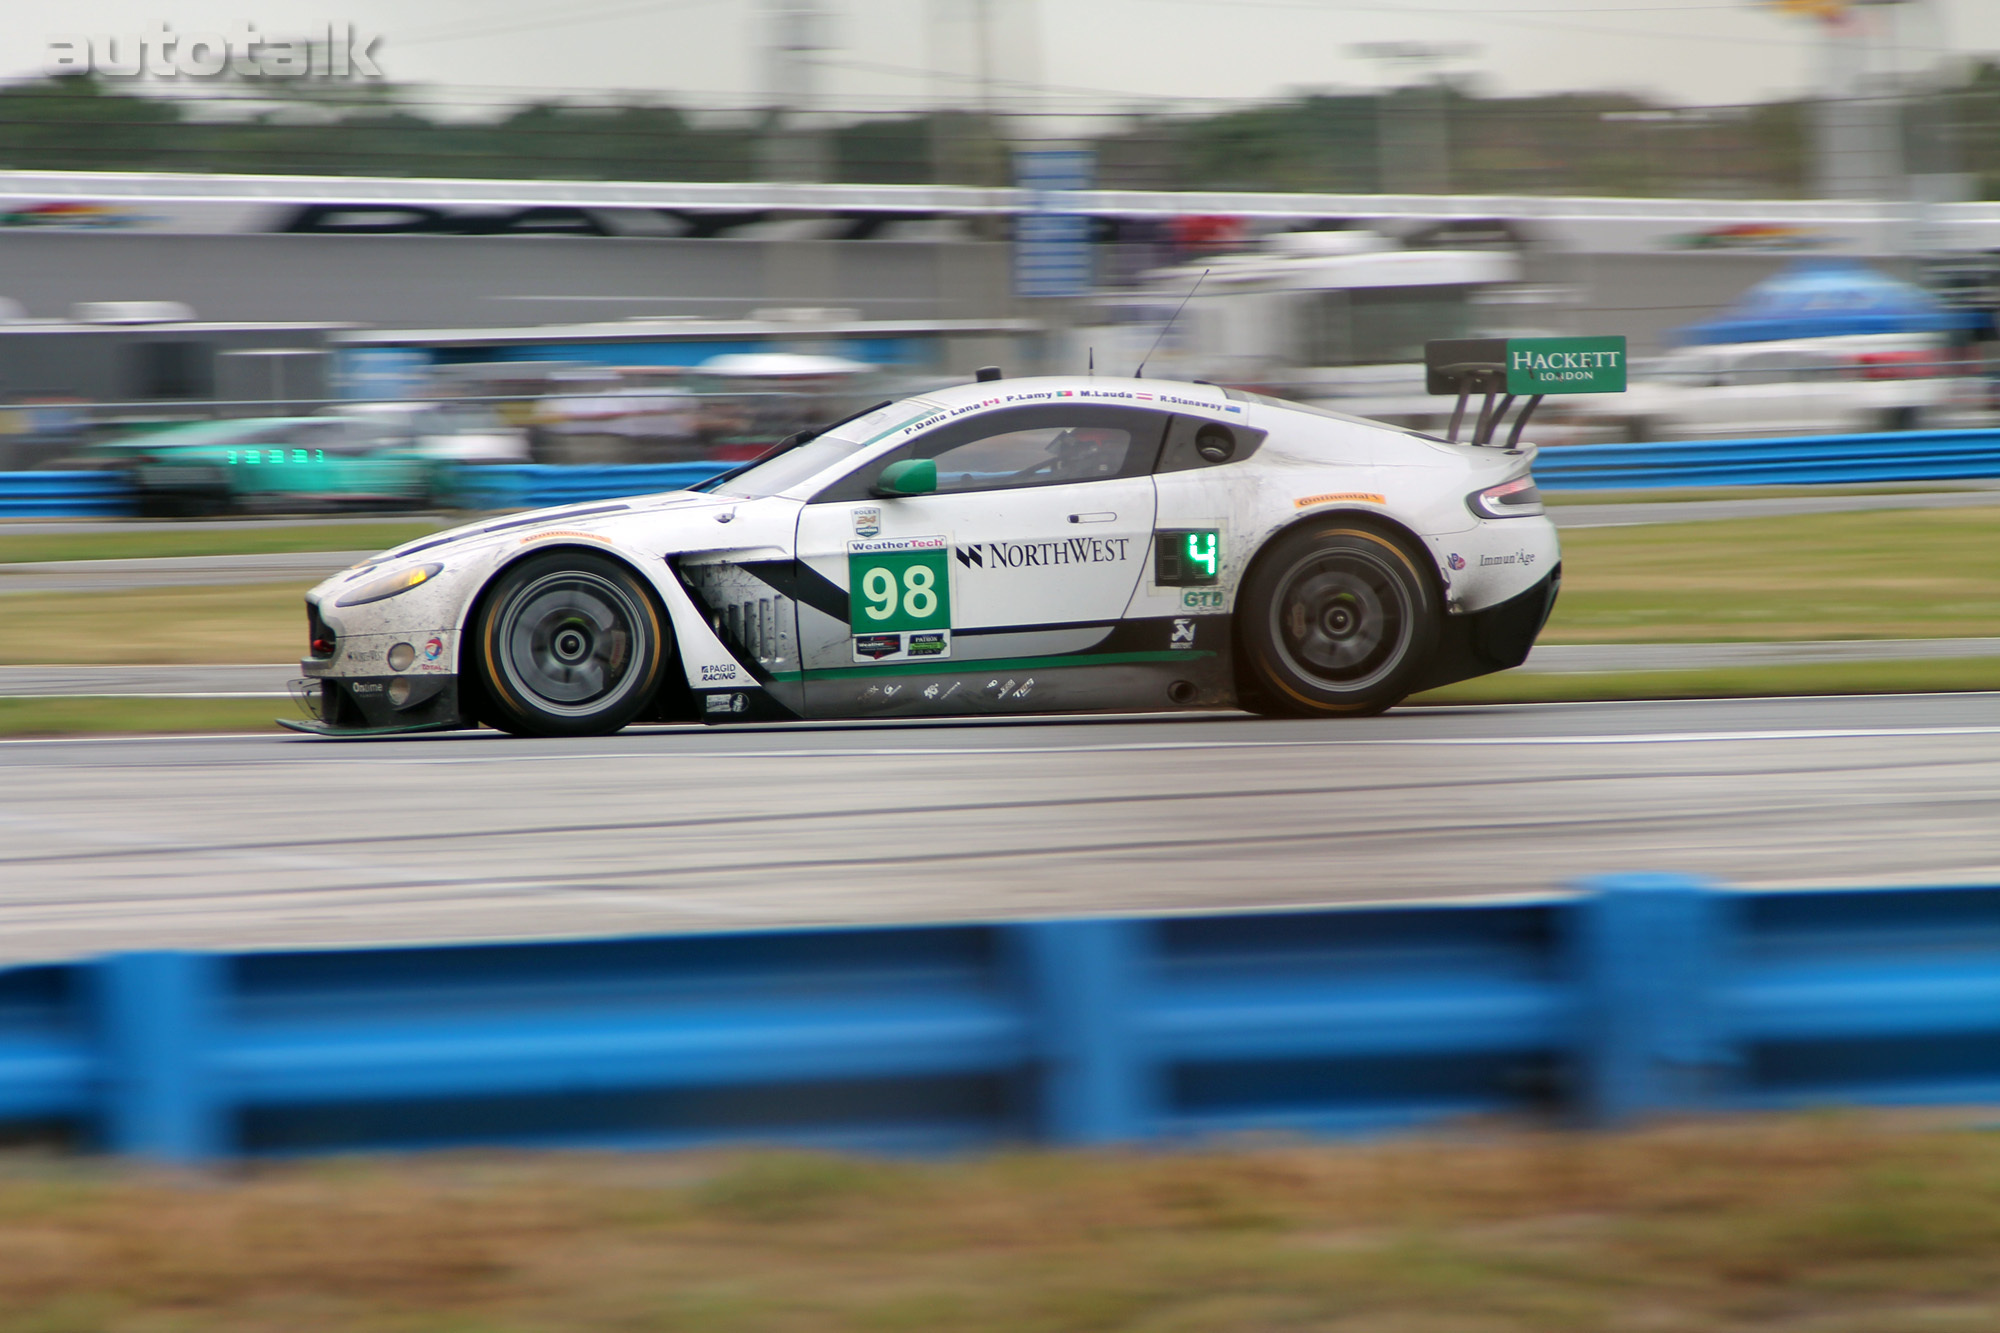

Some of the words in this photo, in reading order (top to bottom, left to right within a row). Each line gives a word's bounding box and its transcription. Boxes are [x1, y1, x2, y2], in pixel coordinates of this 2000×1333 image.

[1512, 352, 1620, 369] HACKETT
[1540, 371, 1594, 382] LONDON
[1006, 391, 1053, 403] P.Lamy
[1079, 390, 1133, 400] M.Lauda
[1159, 395, 1222, 412] R.Stanaway
[904, 413, 947, 435] P.Dalla
[950, 403, 981, 417] Lana
[1299, 493, 1369, 506] Continental
[856, 515, 877, 525] 24
[852, 539, 943, 551] WeatherTech
[990, 537, 1129, 568] NORTHWEST
[1188, 534, 1215, 574] 4
[862, 565, 938, 621] 98
[1184, 591, 1223, 607] GTD
[709, 664, 736, 673] PAGID
[702, 672, 736, 681] RACING
